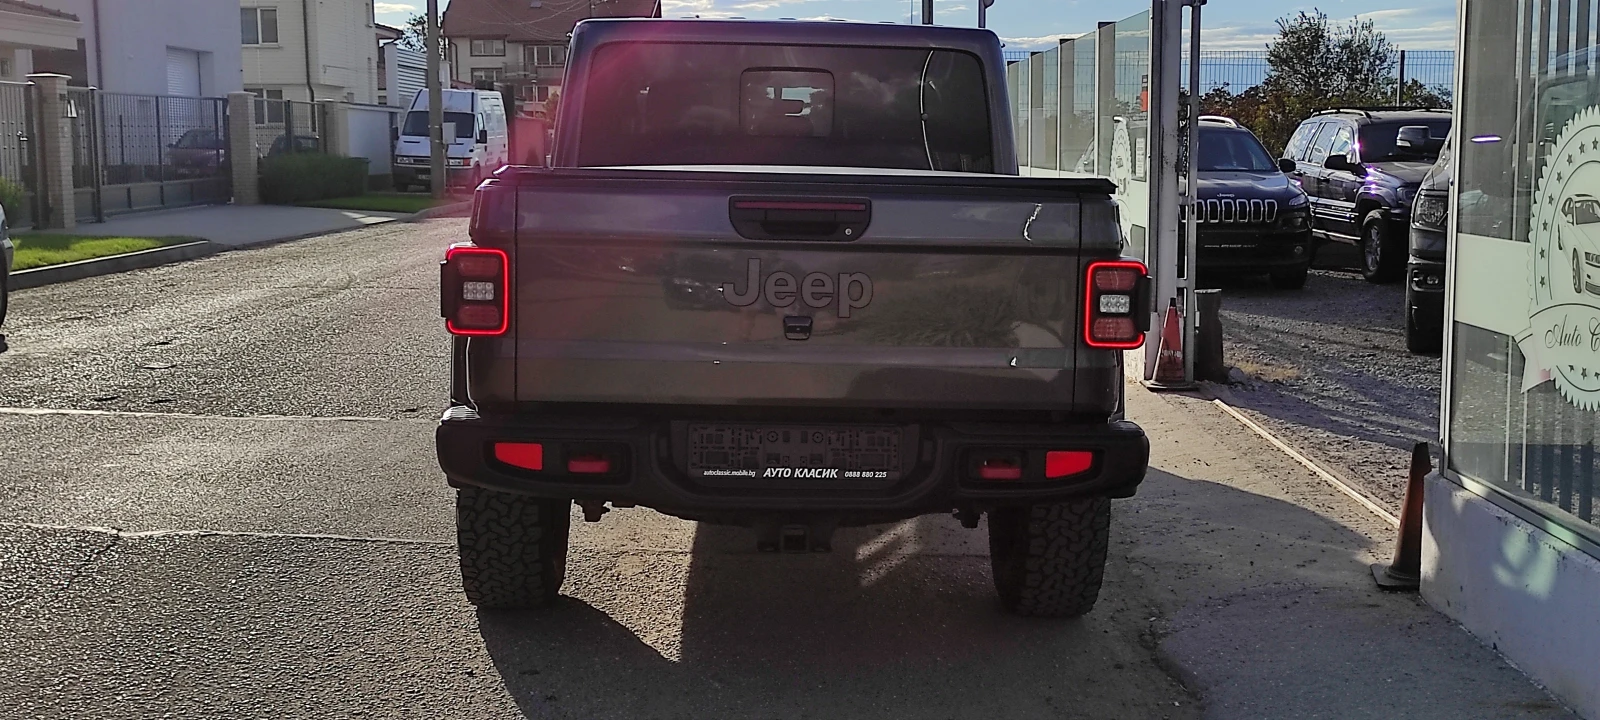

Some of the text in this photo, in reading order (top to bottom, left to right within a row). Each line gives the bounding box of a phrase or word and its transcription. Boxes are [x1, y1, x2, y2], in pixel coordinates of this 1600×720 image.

[722, 257, 874, 319] Jeep
[1544, 313, 1582, 349] Auto
[703, 469, 756, 478] autoclassic.mobile.bg
[763, 467, 839, 479] АУТО КЛАСИК
